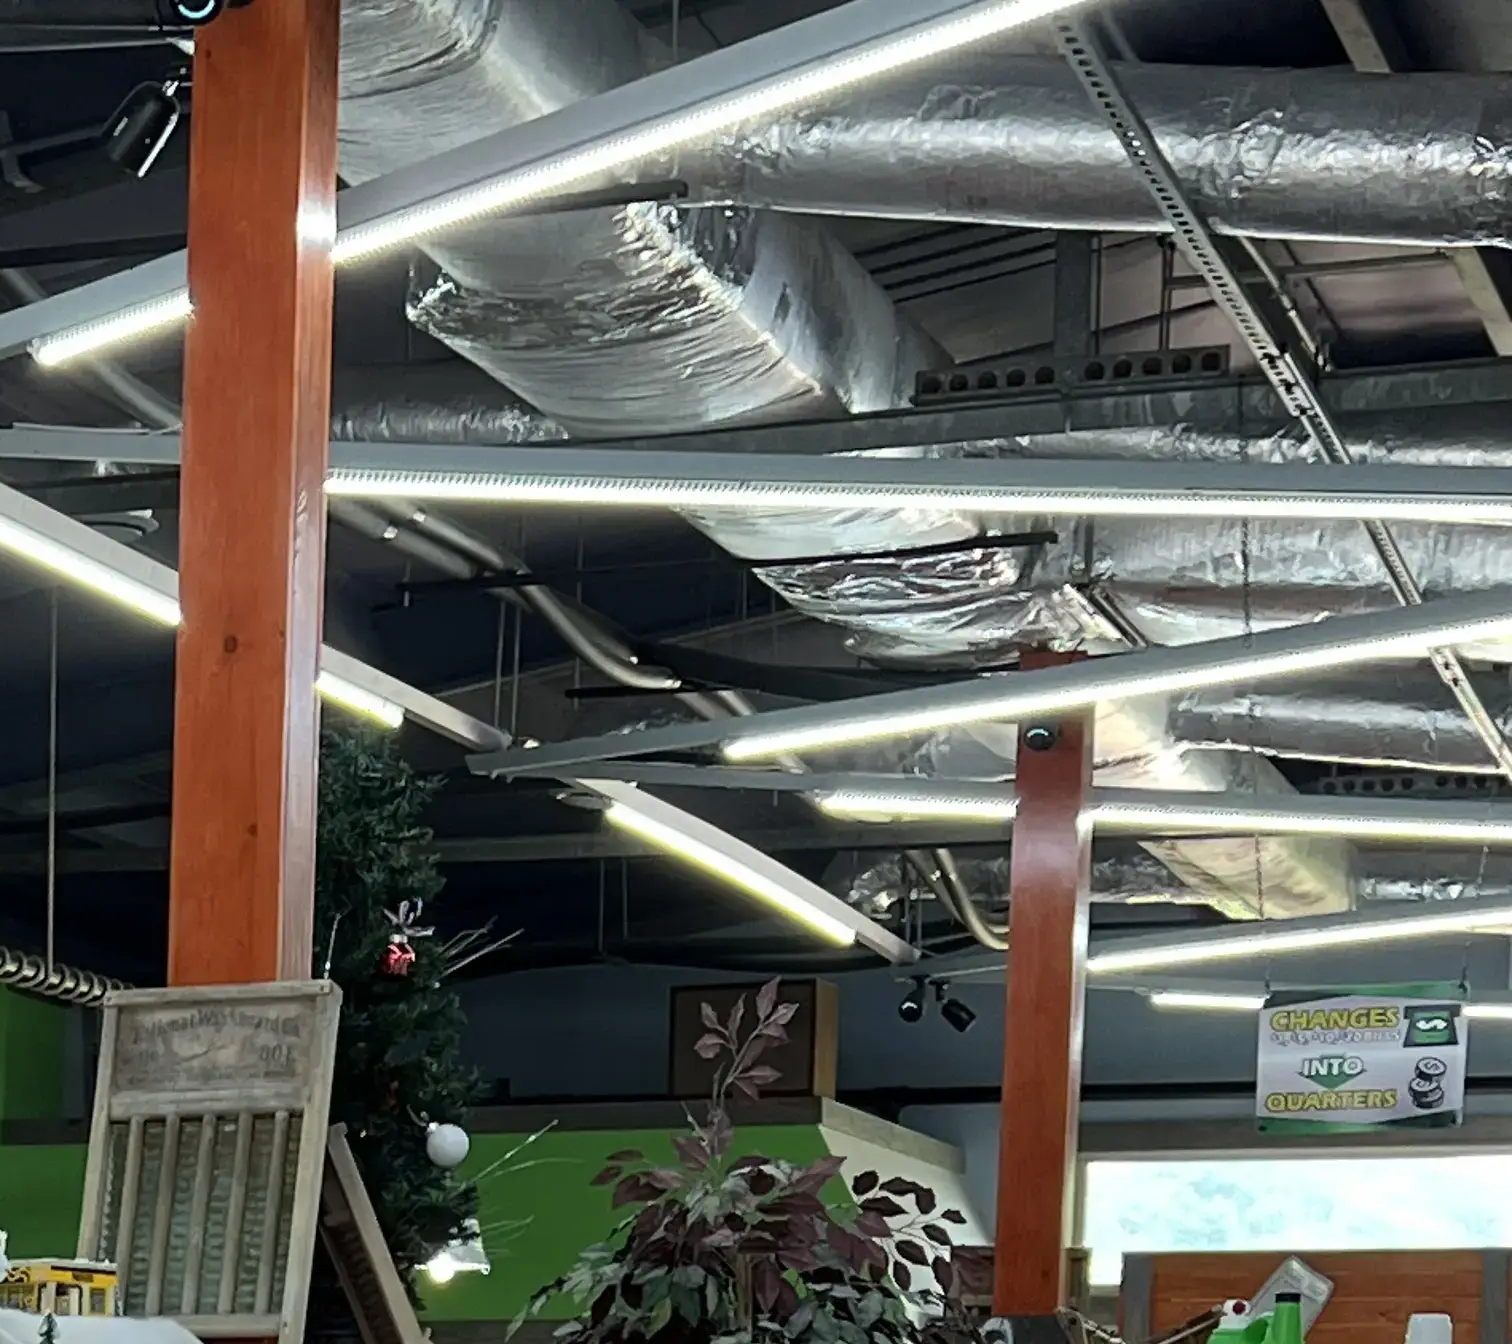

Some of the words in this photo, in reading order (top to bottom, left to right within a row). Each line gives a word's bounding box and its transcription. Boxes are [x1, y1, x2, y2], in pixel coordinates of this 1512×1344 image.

[1270, 1007, 1400, 1032] CHANGES
[1303, 1057, 1364, 1077] INTO
[1265, 1089, 1398, 1112] QUARTERS
